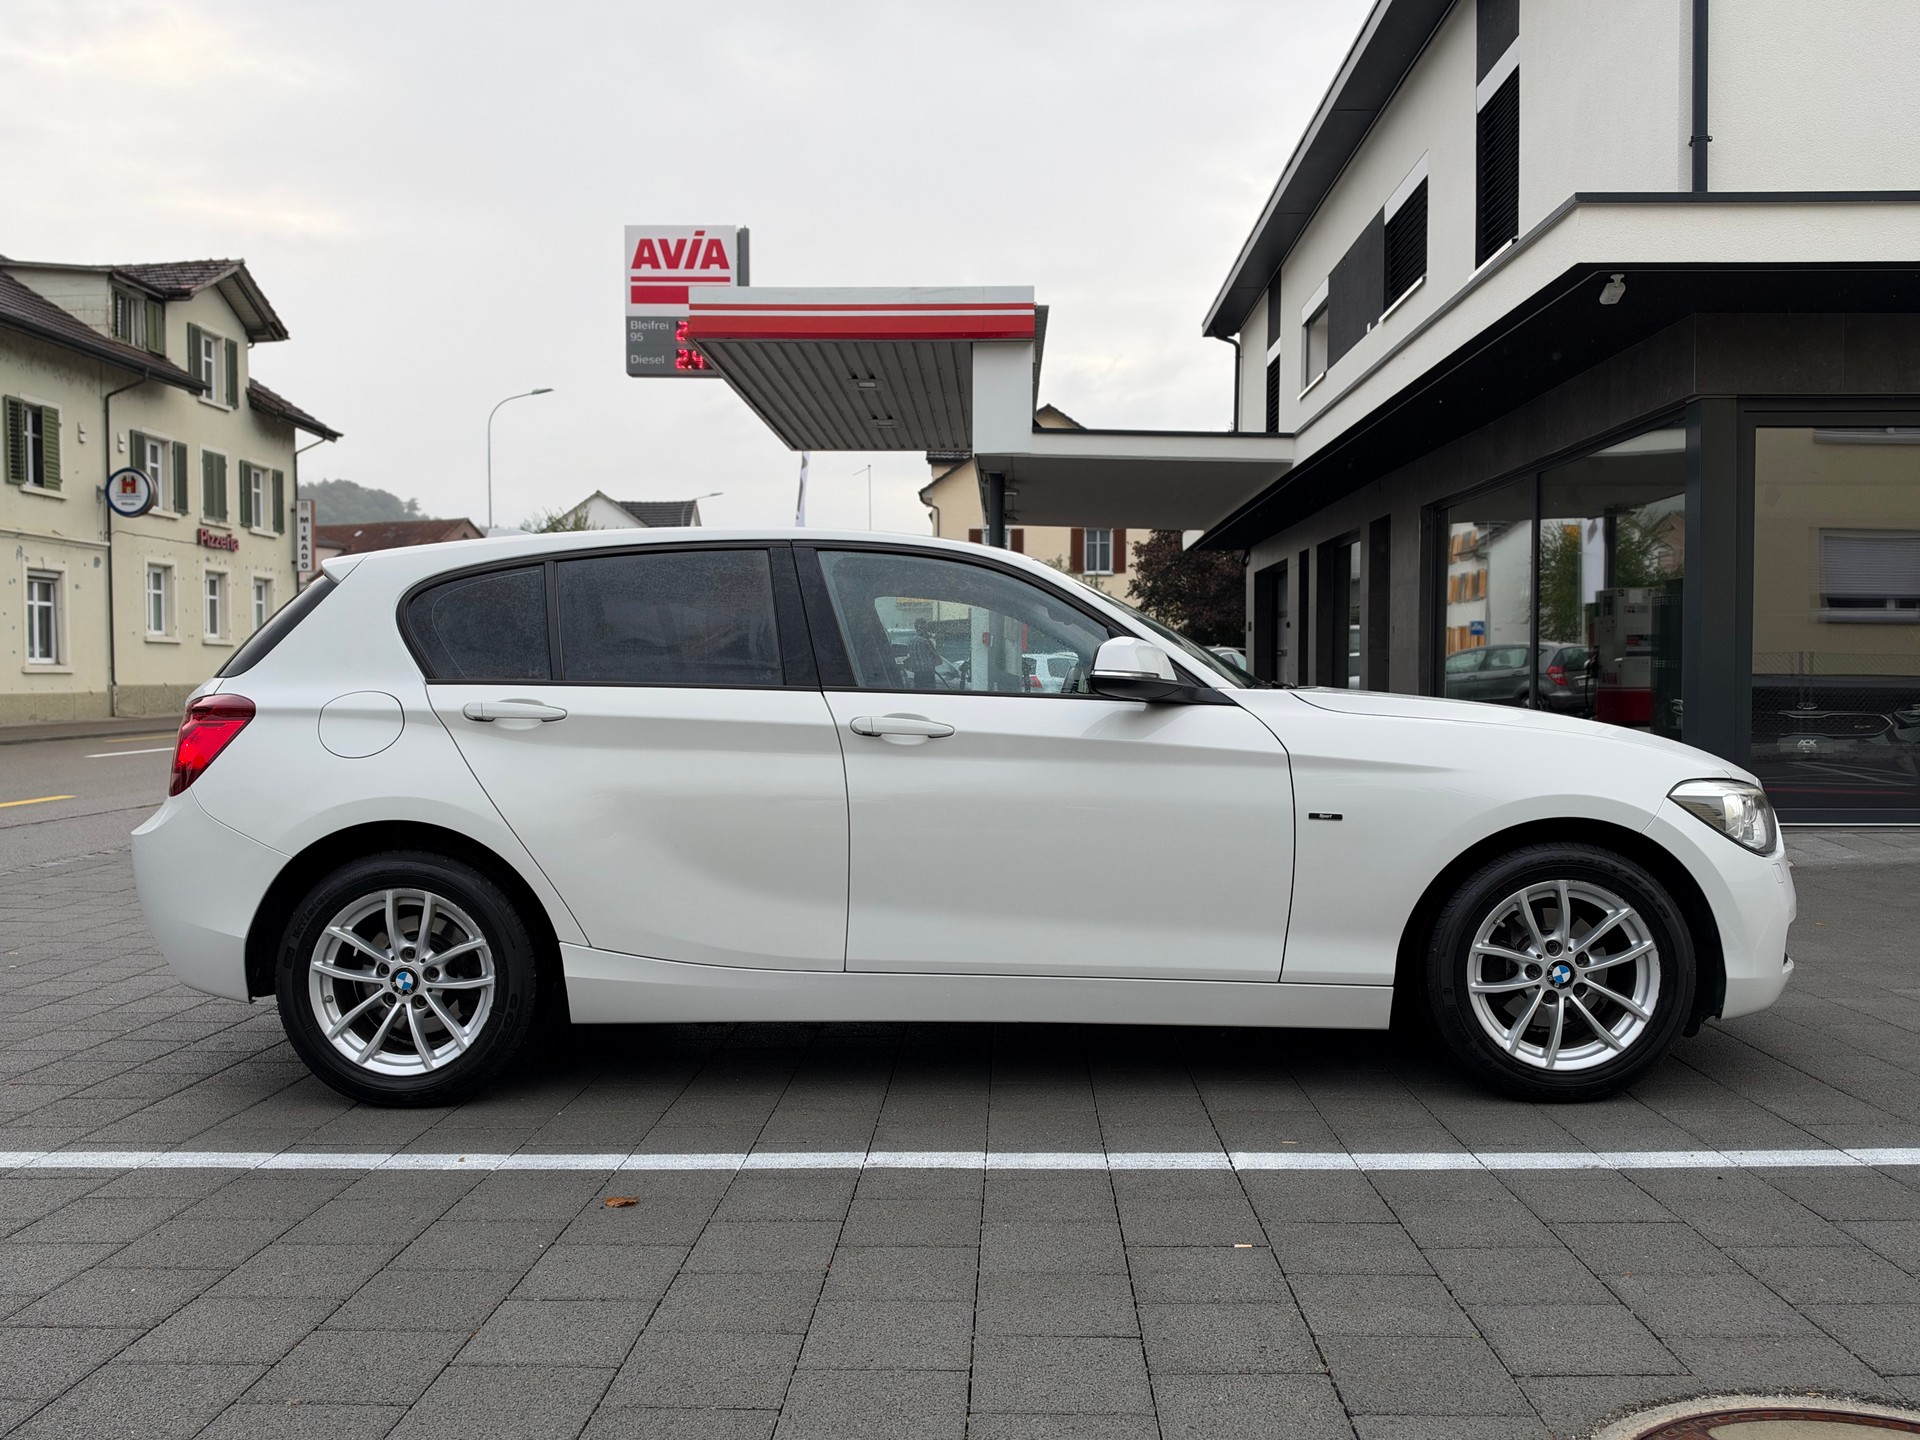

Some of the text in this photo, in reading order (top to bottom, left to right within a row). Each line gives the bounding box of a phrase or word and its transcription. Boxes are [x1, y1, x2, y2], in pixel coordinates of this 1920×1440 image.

[630, 320, 669, 330] Bleifrei
[630, 332, 644, 342] 95
[630, 354, 665, 365] Diesel
[200, 528, 239, 551] Pizzeria
[299, 516, 309, 569] MIKADO
